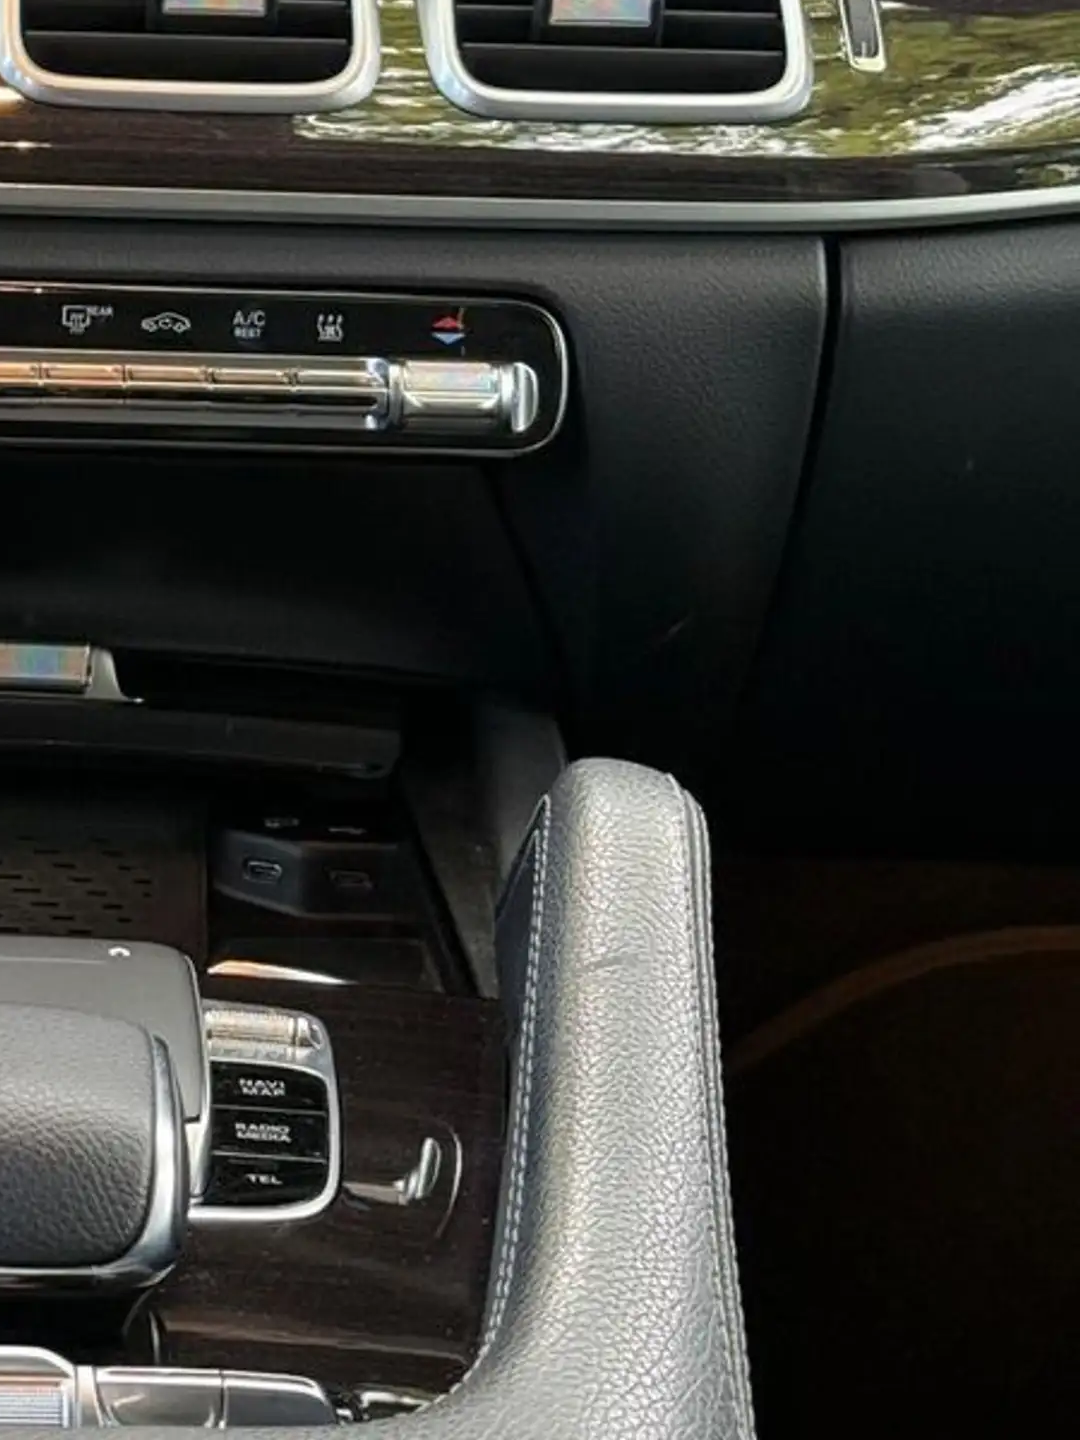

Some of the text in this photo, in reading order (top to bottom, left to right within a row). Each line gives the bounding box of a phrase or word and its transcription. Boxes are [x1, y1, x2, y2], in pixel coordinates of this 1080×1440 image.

[233, 309, 266, 326] A/C
[240, 1078, 285, 1088] NAVI
[235, 1123, 290, 1134] RADIO
[237, 1131, 292, 1143] MEDIA
[245, 1174, 283, 1185] TEL
